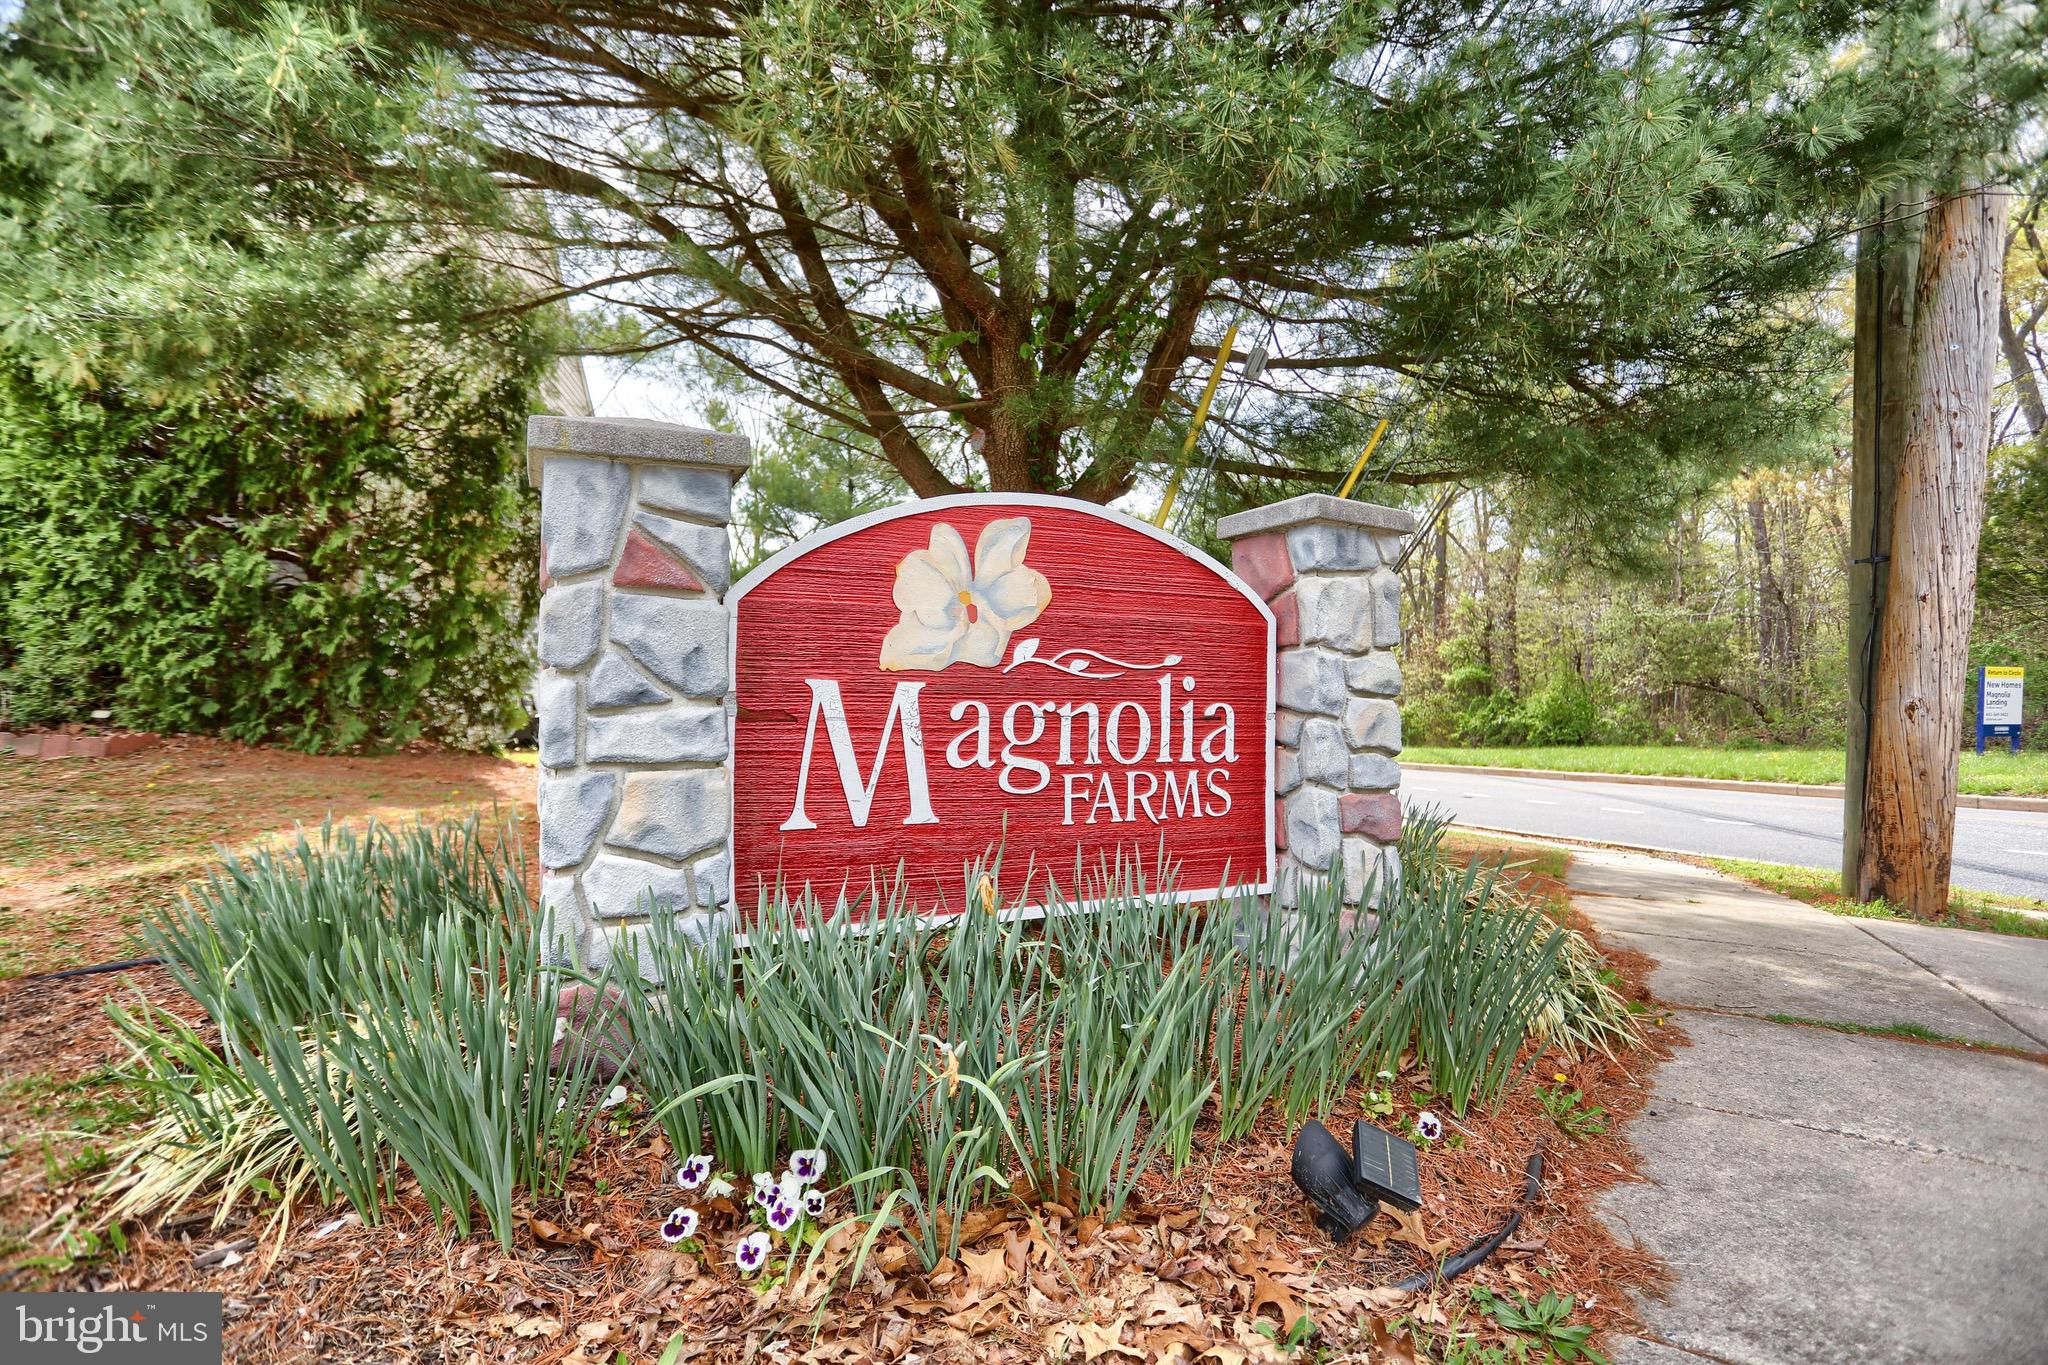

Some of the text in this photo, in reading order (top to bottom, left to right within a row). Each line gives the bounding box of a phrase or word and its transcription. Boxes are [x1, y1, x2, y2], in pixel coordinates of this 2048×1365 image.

[2001, 681, 2022, 689] Homes
[1986, 691, 2011, 699] Magnolia
[1986, 699, 2008, 707] Landing
[779, 673, 1239, 831] Magnolia
[1061, 769, 1232, 826] FARMS
